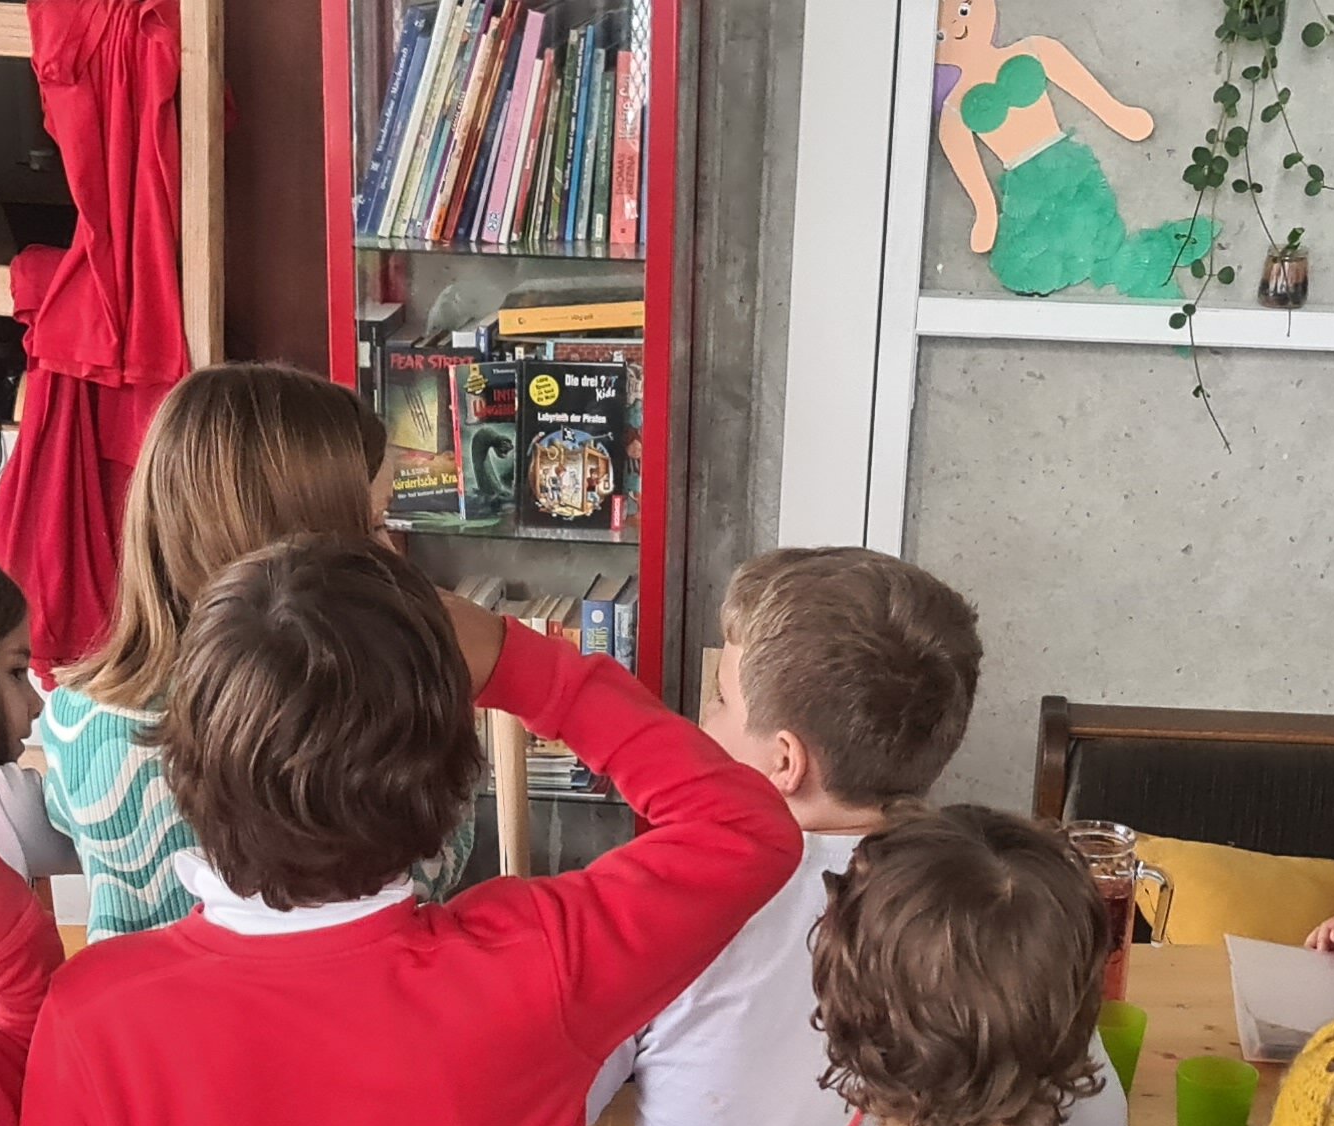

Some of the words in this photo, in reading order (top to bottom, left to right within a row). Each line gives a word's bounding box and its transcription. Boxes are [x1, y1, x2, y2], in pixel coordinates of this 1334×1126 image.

[615, 153, 625, 195] THOMAS
[626, 156, 635, 194] BREZINA
[390, 353, 425, 369] FEAR
[565, 374, 579, 386] Die
[581, 375, 598, 387] drei
[595, 387, 616, 402] Kids
[537, 412, 568, 423] Labyrinth
[570, 414, 581, 423] der
[582, 414, 606, 423] Piraten
